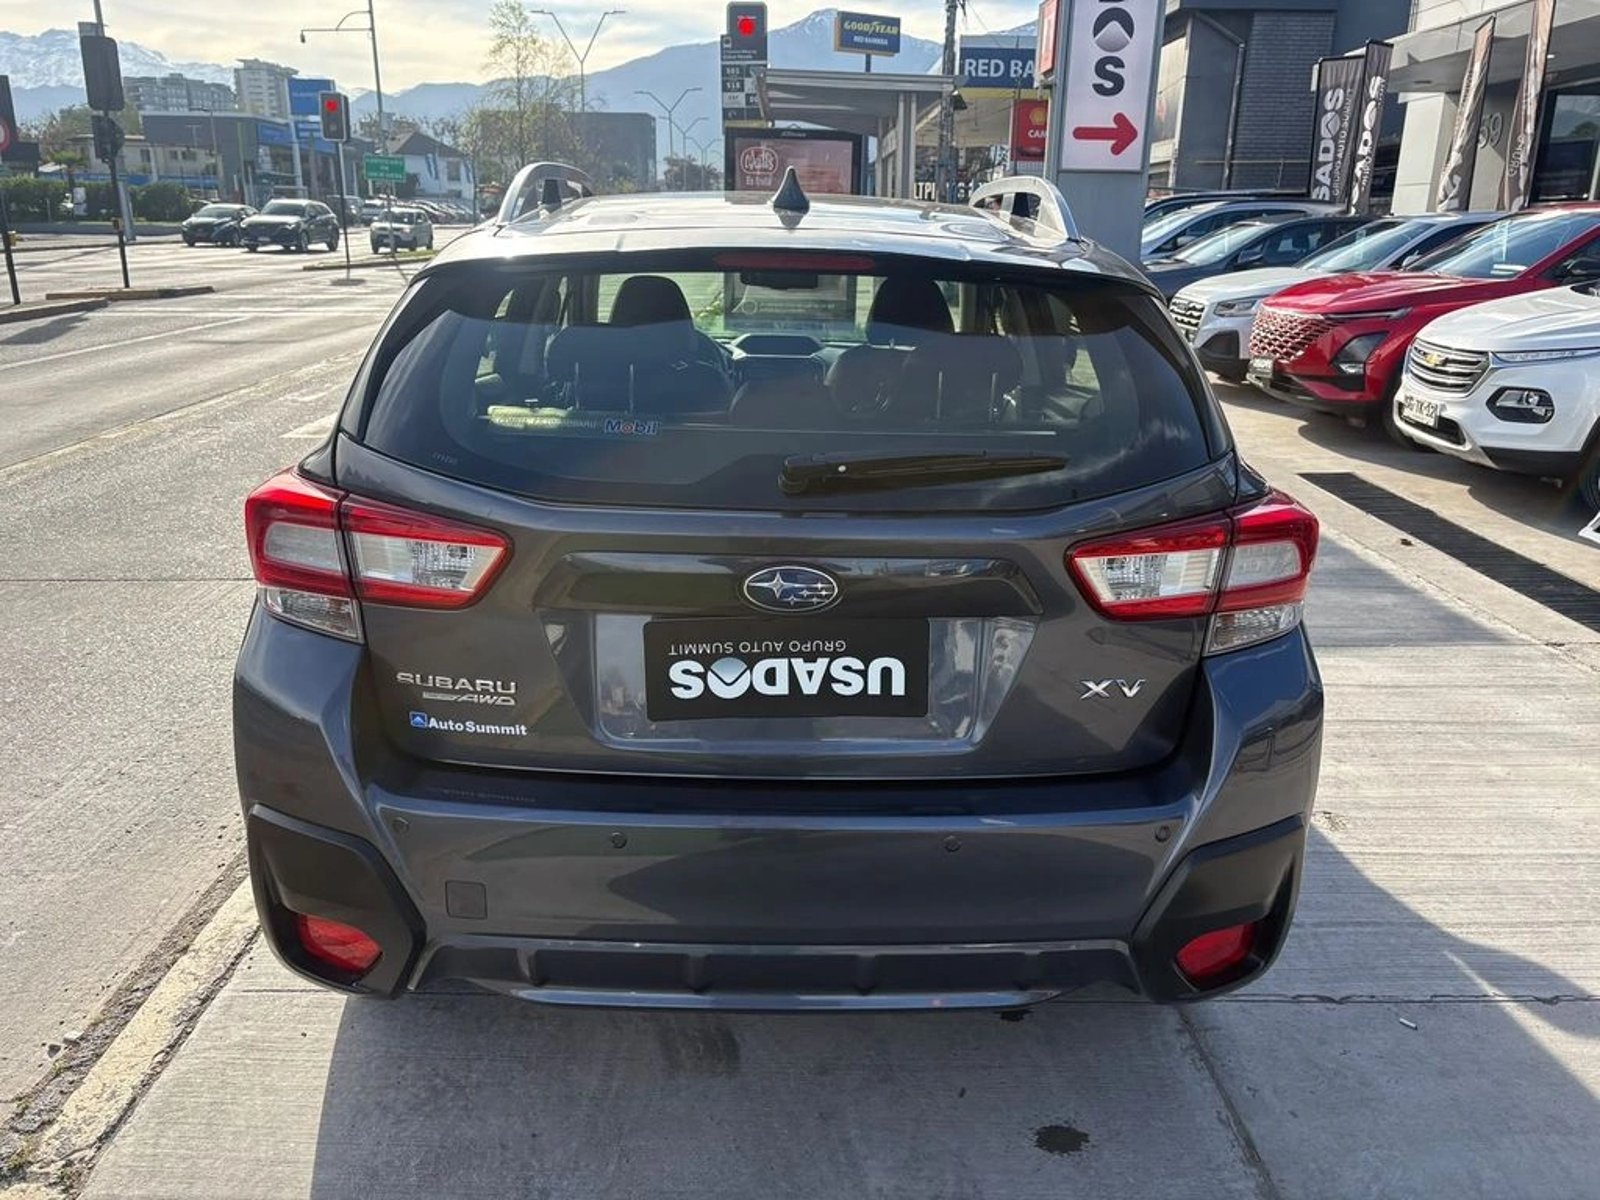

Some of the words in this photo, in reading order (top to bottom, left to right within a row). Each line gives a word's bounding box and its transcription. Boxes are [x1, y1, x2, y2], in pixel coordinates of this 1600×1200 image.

[843, 20, 899, 35] GOODYEAR
[964, 58, 1005, 78] RED
[604, 418, 658, 435] Mobil
[668, 641, 734, 655] SUMMIT
[740, 641, 784, 653] AUTO
[789, 640, 846, 652] GRUPO
[396, 671, 516, 694] SUBARU
[668, 656, 906, 700] USADOS
